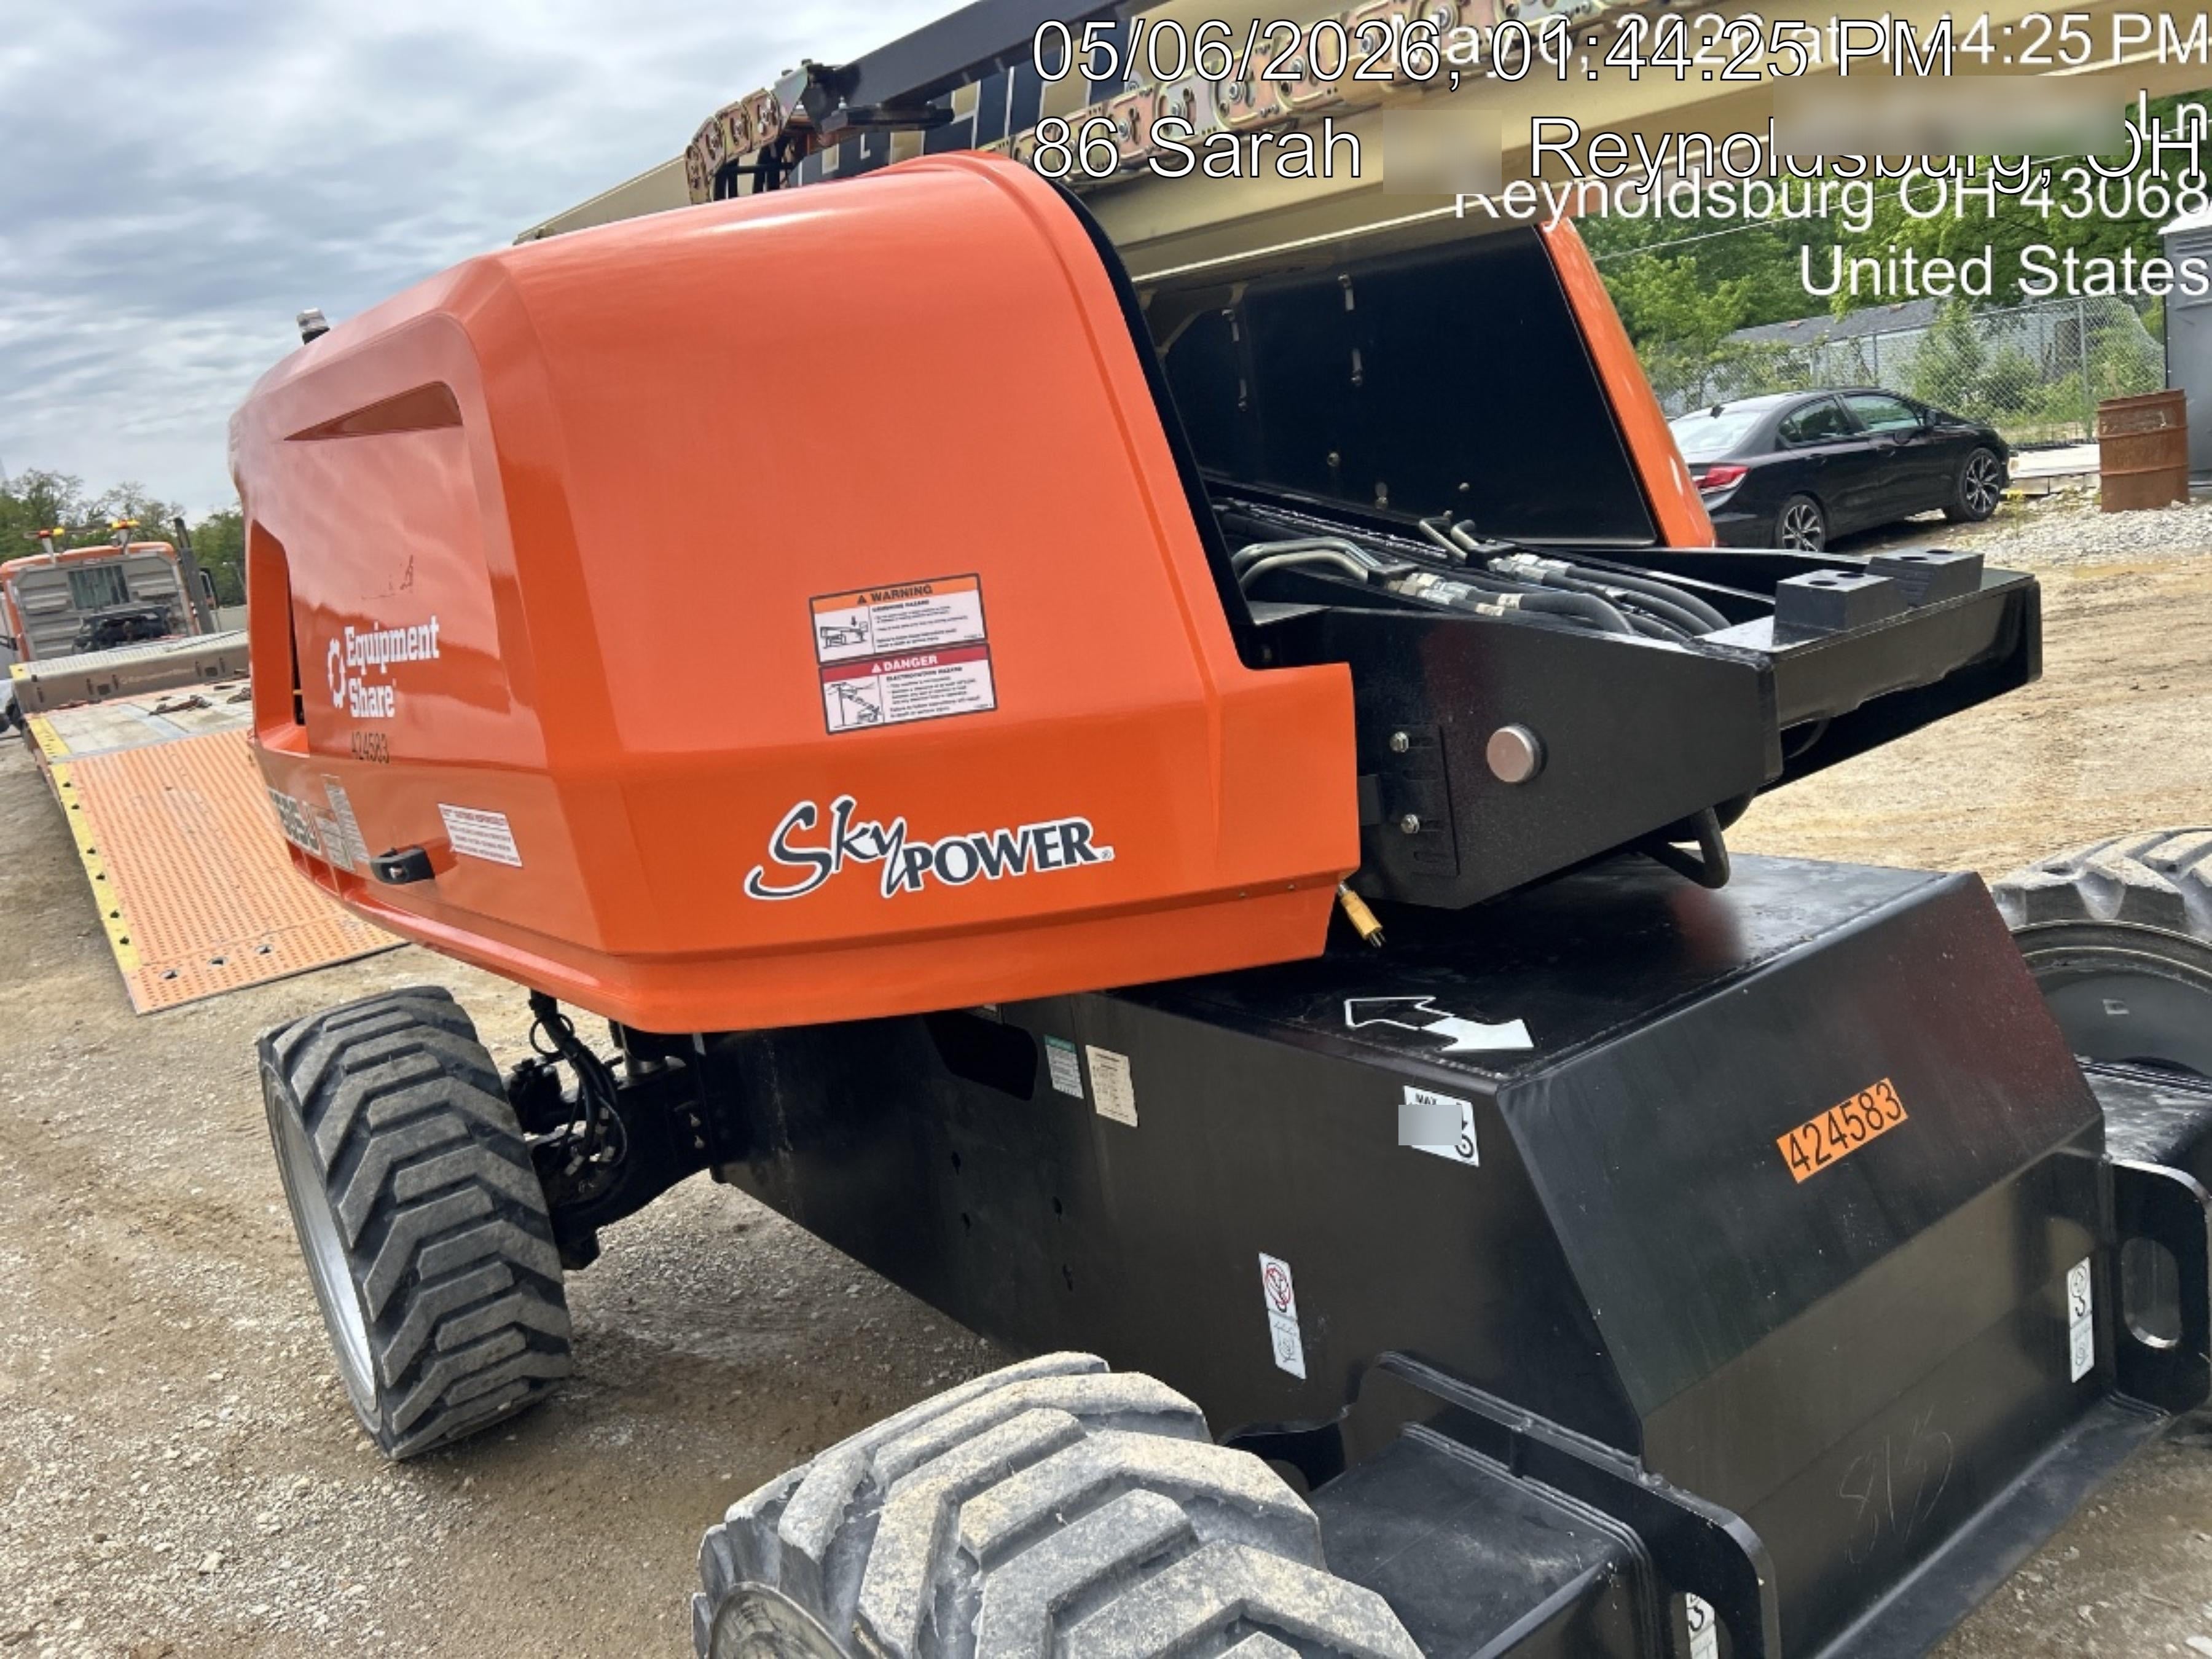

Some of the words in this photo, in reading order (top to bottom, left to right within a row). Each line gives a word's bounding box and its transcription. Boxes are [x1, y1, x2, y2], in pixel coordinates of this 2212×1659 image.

[871, 585, 933, 602] WARNING
[345, 615, 439, 675] Equipment
[883, 655, 938, 672] DANGER
[349, 678, 395, 718] Share
[1789, 1082, 1901, 1172] 424583
